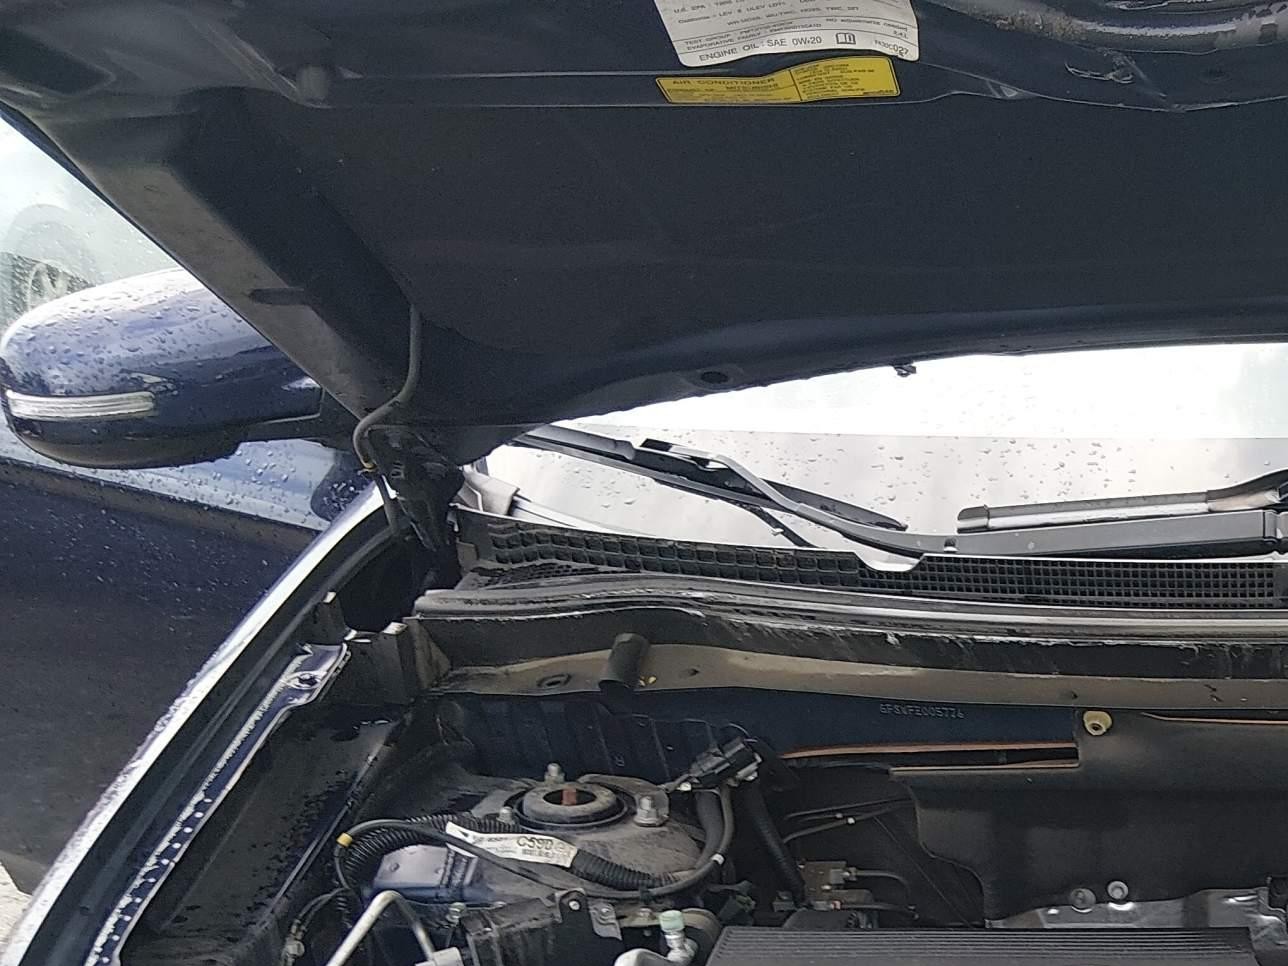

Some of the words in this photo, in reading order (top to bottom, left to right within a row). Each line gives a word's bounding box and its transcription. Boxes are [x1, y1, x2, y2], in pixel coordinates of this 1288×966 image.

[698, 47, 738, 61] ENGINE
[742, 42, 760, 51] OIL
[767, 38, 787, 47] SAE
[695, 77, 775, 86] CONDITIONER
